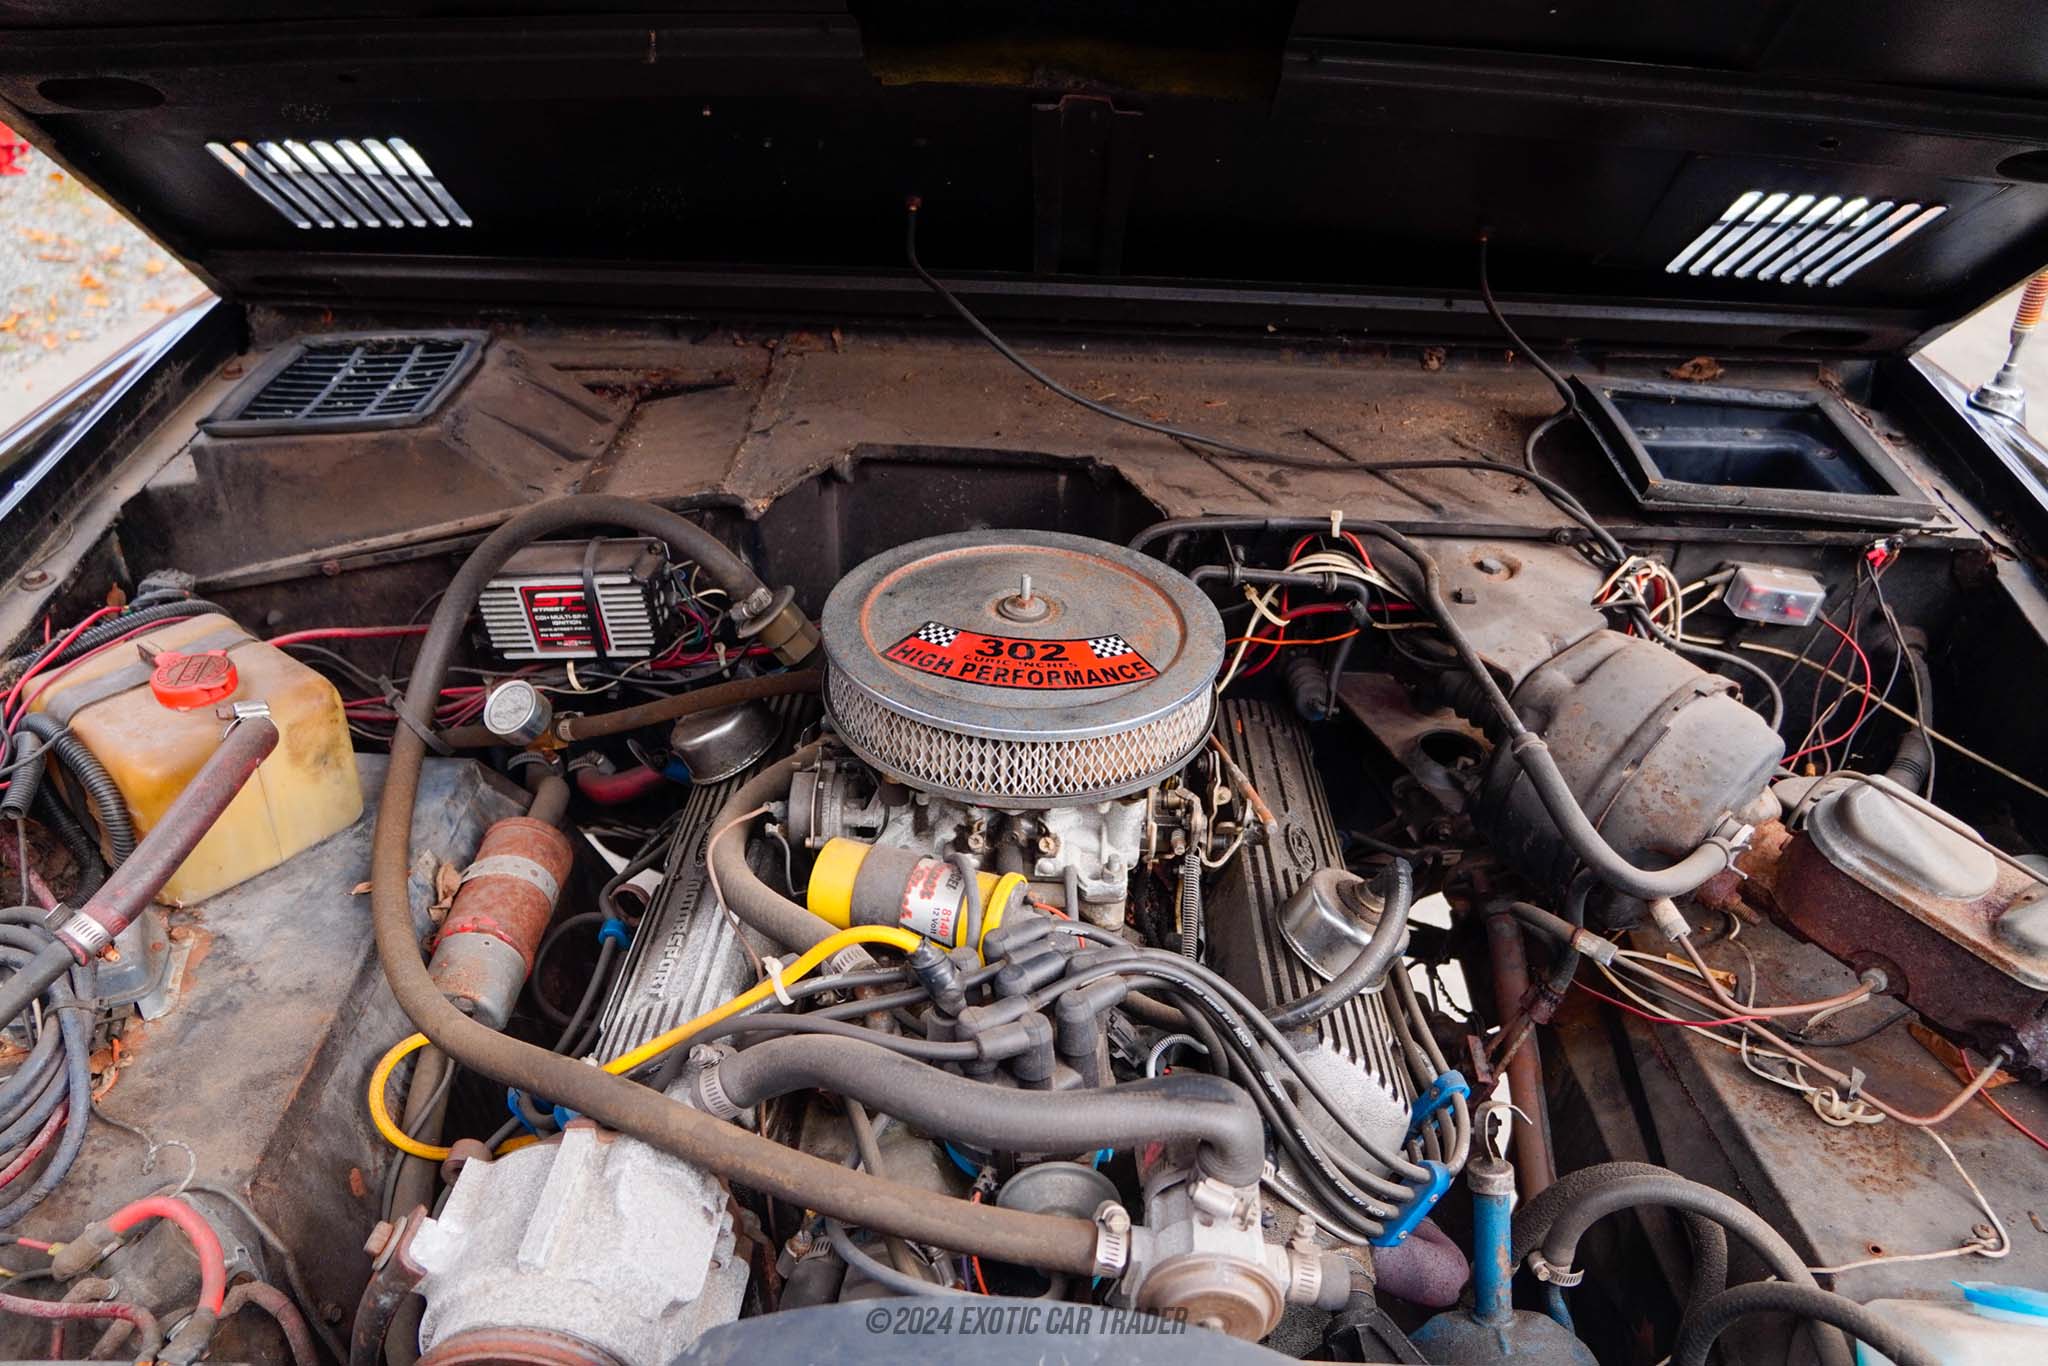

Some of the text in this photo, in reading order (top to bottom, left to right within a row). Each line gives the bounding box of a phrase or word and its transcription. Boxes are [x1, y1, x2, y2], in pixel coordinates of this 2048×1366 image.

[893, 643, 1151, 686] HIGH PERFORMANCE
[975, 638, 1069, 661] 302
[930, 907, 940, 935] 12 Volt
[938, 908, 952, 938] 8140
[1203, 995, 1224, 1014] WIRE
[1222, 1013, 1235, 1025] BY
[1233, 1027, 1252, 1048] MSD
[1296, 1128, 1322, 1163] STREET
[1334, 1180, 1355, 1201] WIRE
[1352, 1195, 1366, 1206] BY
[1366, 1204, 1386, 1217] MSD
